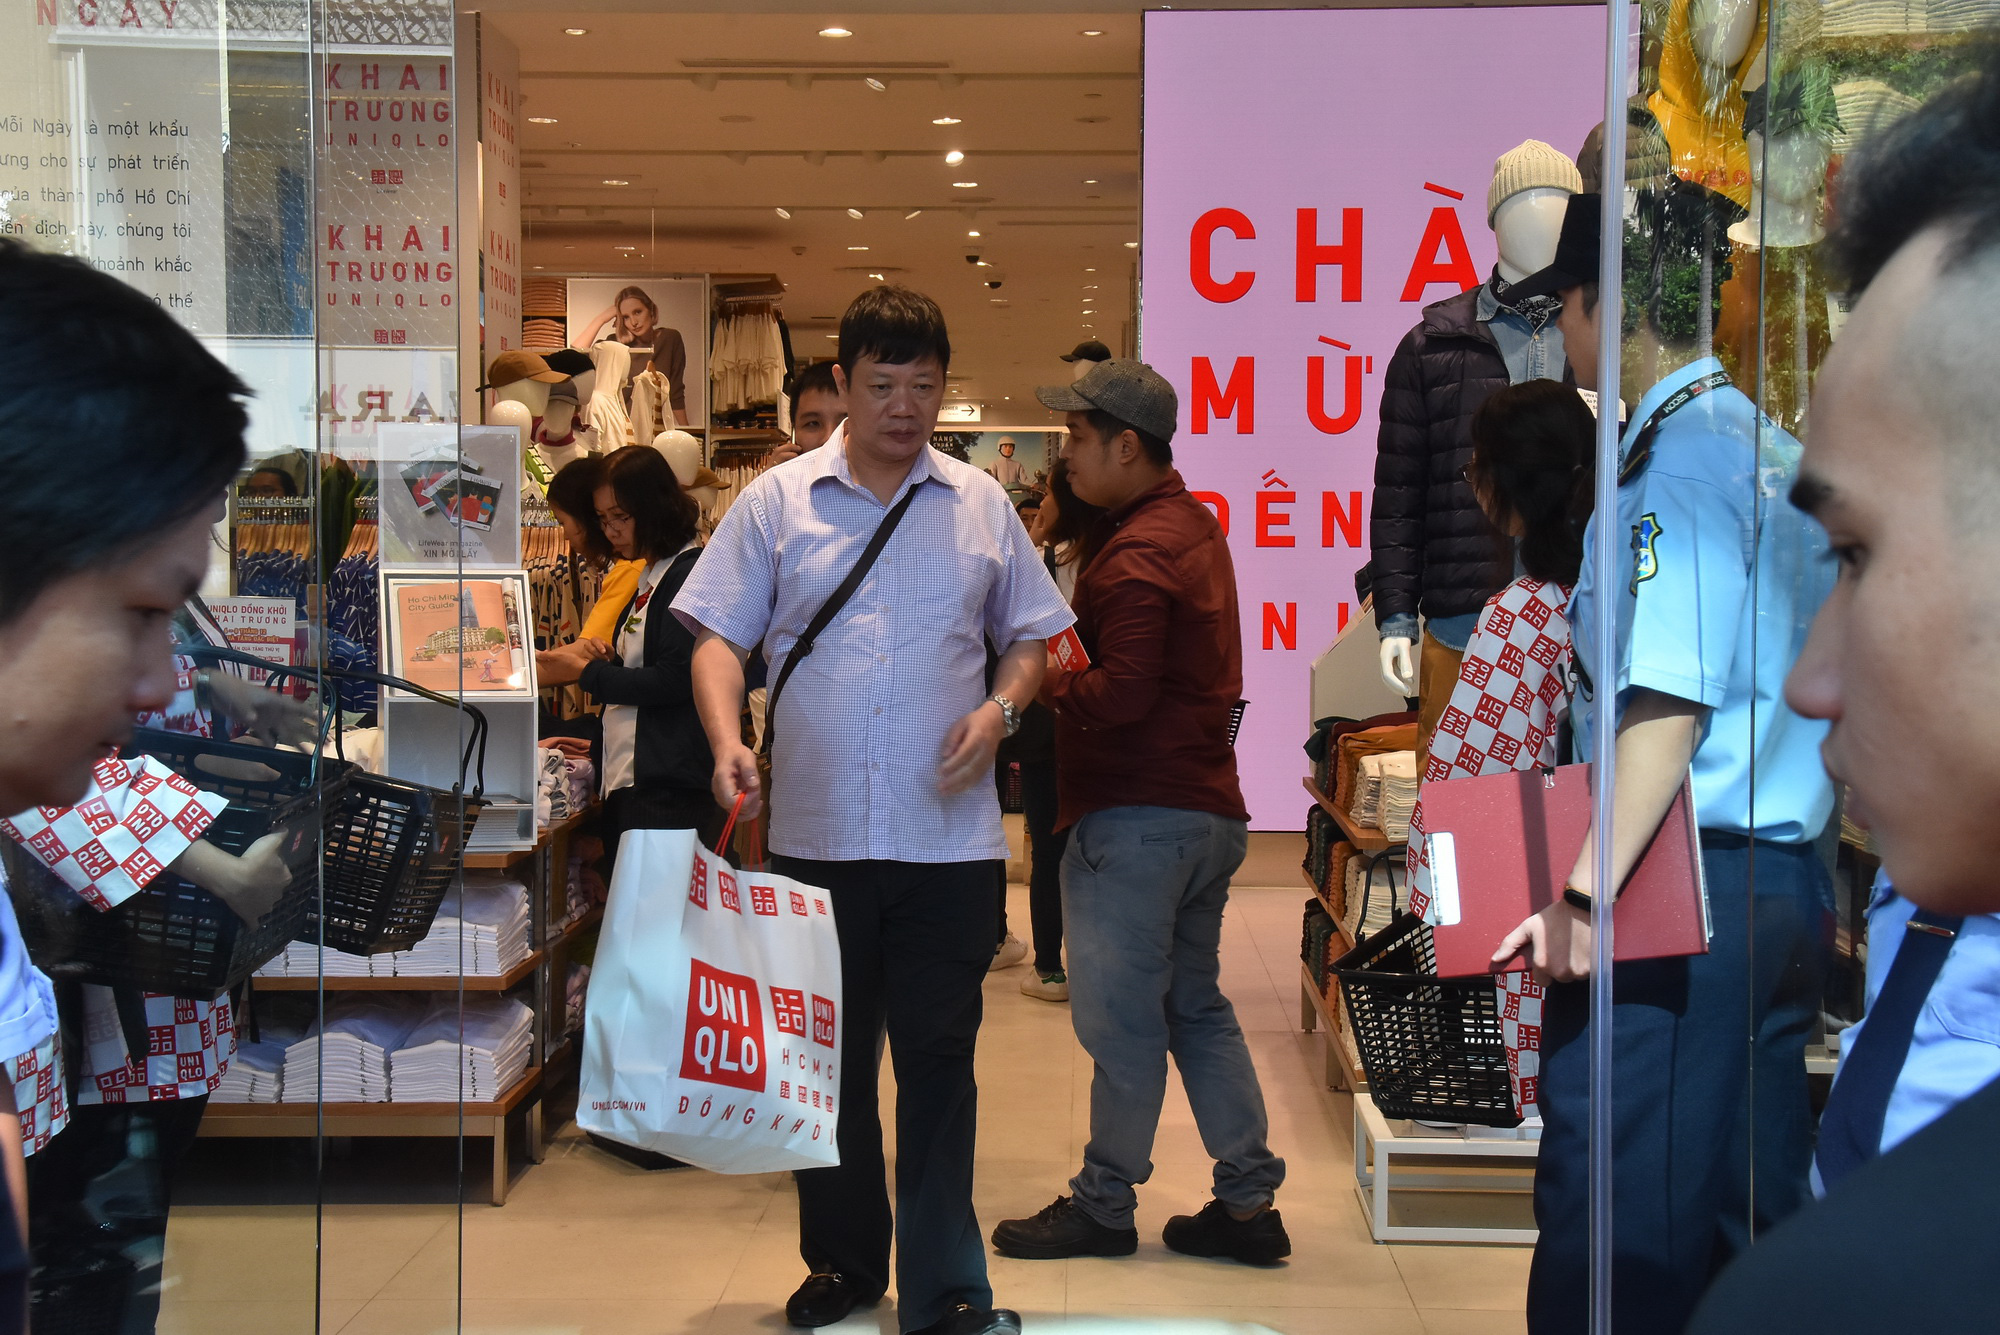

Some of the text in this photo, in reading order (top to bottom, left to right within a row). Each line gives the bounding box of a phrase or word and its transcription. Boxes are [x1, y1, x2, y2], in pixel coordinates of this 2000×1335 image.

[325, 64, 447, 90] KHAI
[488, 72, 514, 115] KHAI
[33, 118, 73, 137] Ngày
[108, 120, 139, 139] một
[149, 119, 189, 136] khẩu
[325, 133, 449, 148] UNIQLO
[40, 153, 68, 168] cho
[78, 155, 97, 172] sự
[108, 153, 142, 172] phát
[152, 152, 190, 171] triển
[40, 186, 84, 202] thành
[96, 187, 124, 206] phố
[135, 189, 156, 205] Hồ
[166, 189, 191, 205] Chí
[35, 221, 67, 239] dịch
[116, 223, 164, 239] chúng
[173, 223, 191, 238] tôi
[328, 225, 449, 251] KHAI
[490, 230, 516, 267] KHAI
[154, 255, 192, 272] khắc
[327, 293, 451, 308] UNIQLO
[1663, 391, 1689, 413] SECOM
[424, 550, 438, 558] XIN
[450, 540, 483, 549] mgazine
[408, 604, 426, 612] City
[422, 594, 437, 602] Chi
[438, 593, 459, 601] Min
[1487, 608, 1503, 631] UNI
[1498, 613, 1513, 636] QLO
[1531, 638, 1549, 659] UNI
[1541, 643, 1558, 666] QLO
[1463, 659, 1480, 681] UNI
[1473, 664, 1490, 687] QLO
[1514, 686, 1528, 708] UNI
[1443, 709, 1458, 731] UNI
[1454, 714, 1468, 735] QLO
[1491, 736, 1508, 757] UNI
[1502, 740, 1518, 762] QLO
[94, 761, 116, 789] UNI
[1426, 759, 1438, 779] UNI
[170, 776, 198, 794] UNI
[138, 803, 164, 828] QLO
[127, 814, 152, 840] UNI
[77, 850, 102, 877] QLO
[88, 842, 112, 868] UNI
[699, 975, 750, 1027] UNI
[814, 1000, 832, 1022] UNI
[178, 1010, 195, 1021] QLO
[814, 1020, 833, 1042] QLO
[180, 1055, 200, 1066] UNI
[694, 1026, 759, 1075] QLO
[20, 1059, 36, 1079] QLO
[180, 1067, 203, 1081] QLO
[782, 1048, 834, 1080] HCMC
[105, 1091, 123, 1103] UNI
